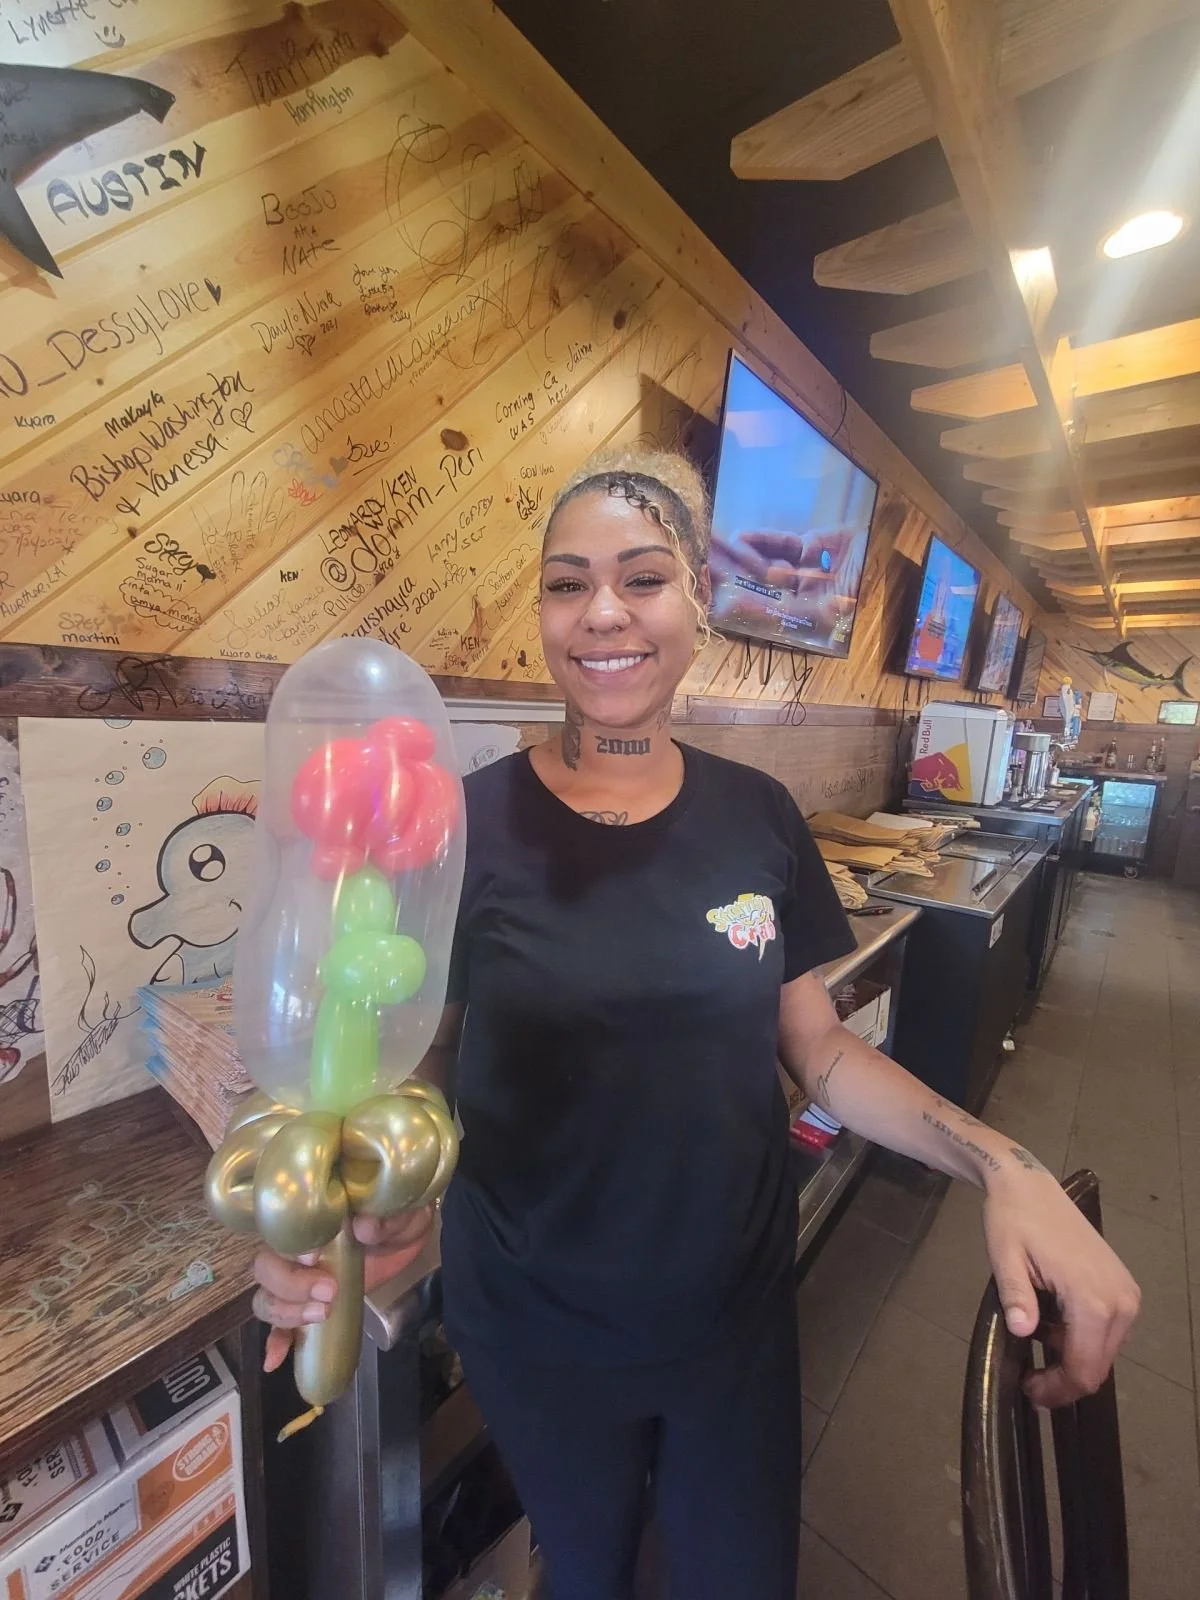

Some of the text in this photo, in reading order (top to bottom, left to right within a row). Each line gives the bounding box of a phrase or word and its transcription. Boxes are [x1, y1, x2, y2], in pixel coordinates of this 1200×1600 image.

[46, 140, 207, 226] AUSTIN
[70, 446, 152, 501] Bishop
[139, 370, 255, 450] Washington
[0, 489, 41, 508] yara
[136, 557, 173, 579] Sugar
[280, 569, 299, 583] KEN
[412, 578, 442, 615] 2021
[62, 631, 120, 645] martini
[460, 634, 481, 652] KEN
[920, 719, 933, 754] Red Bull
[50, 1530, 120, 1591] SERVICE
[63, 1529, 104, 1565] FOOD
[200, 1536, 231, 1571] PLASTIC
